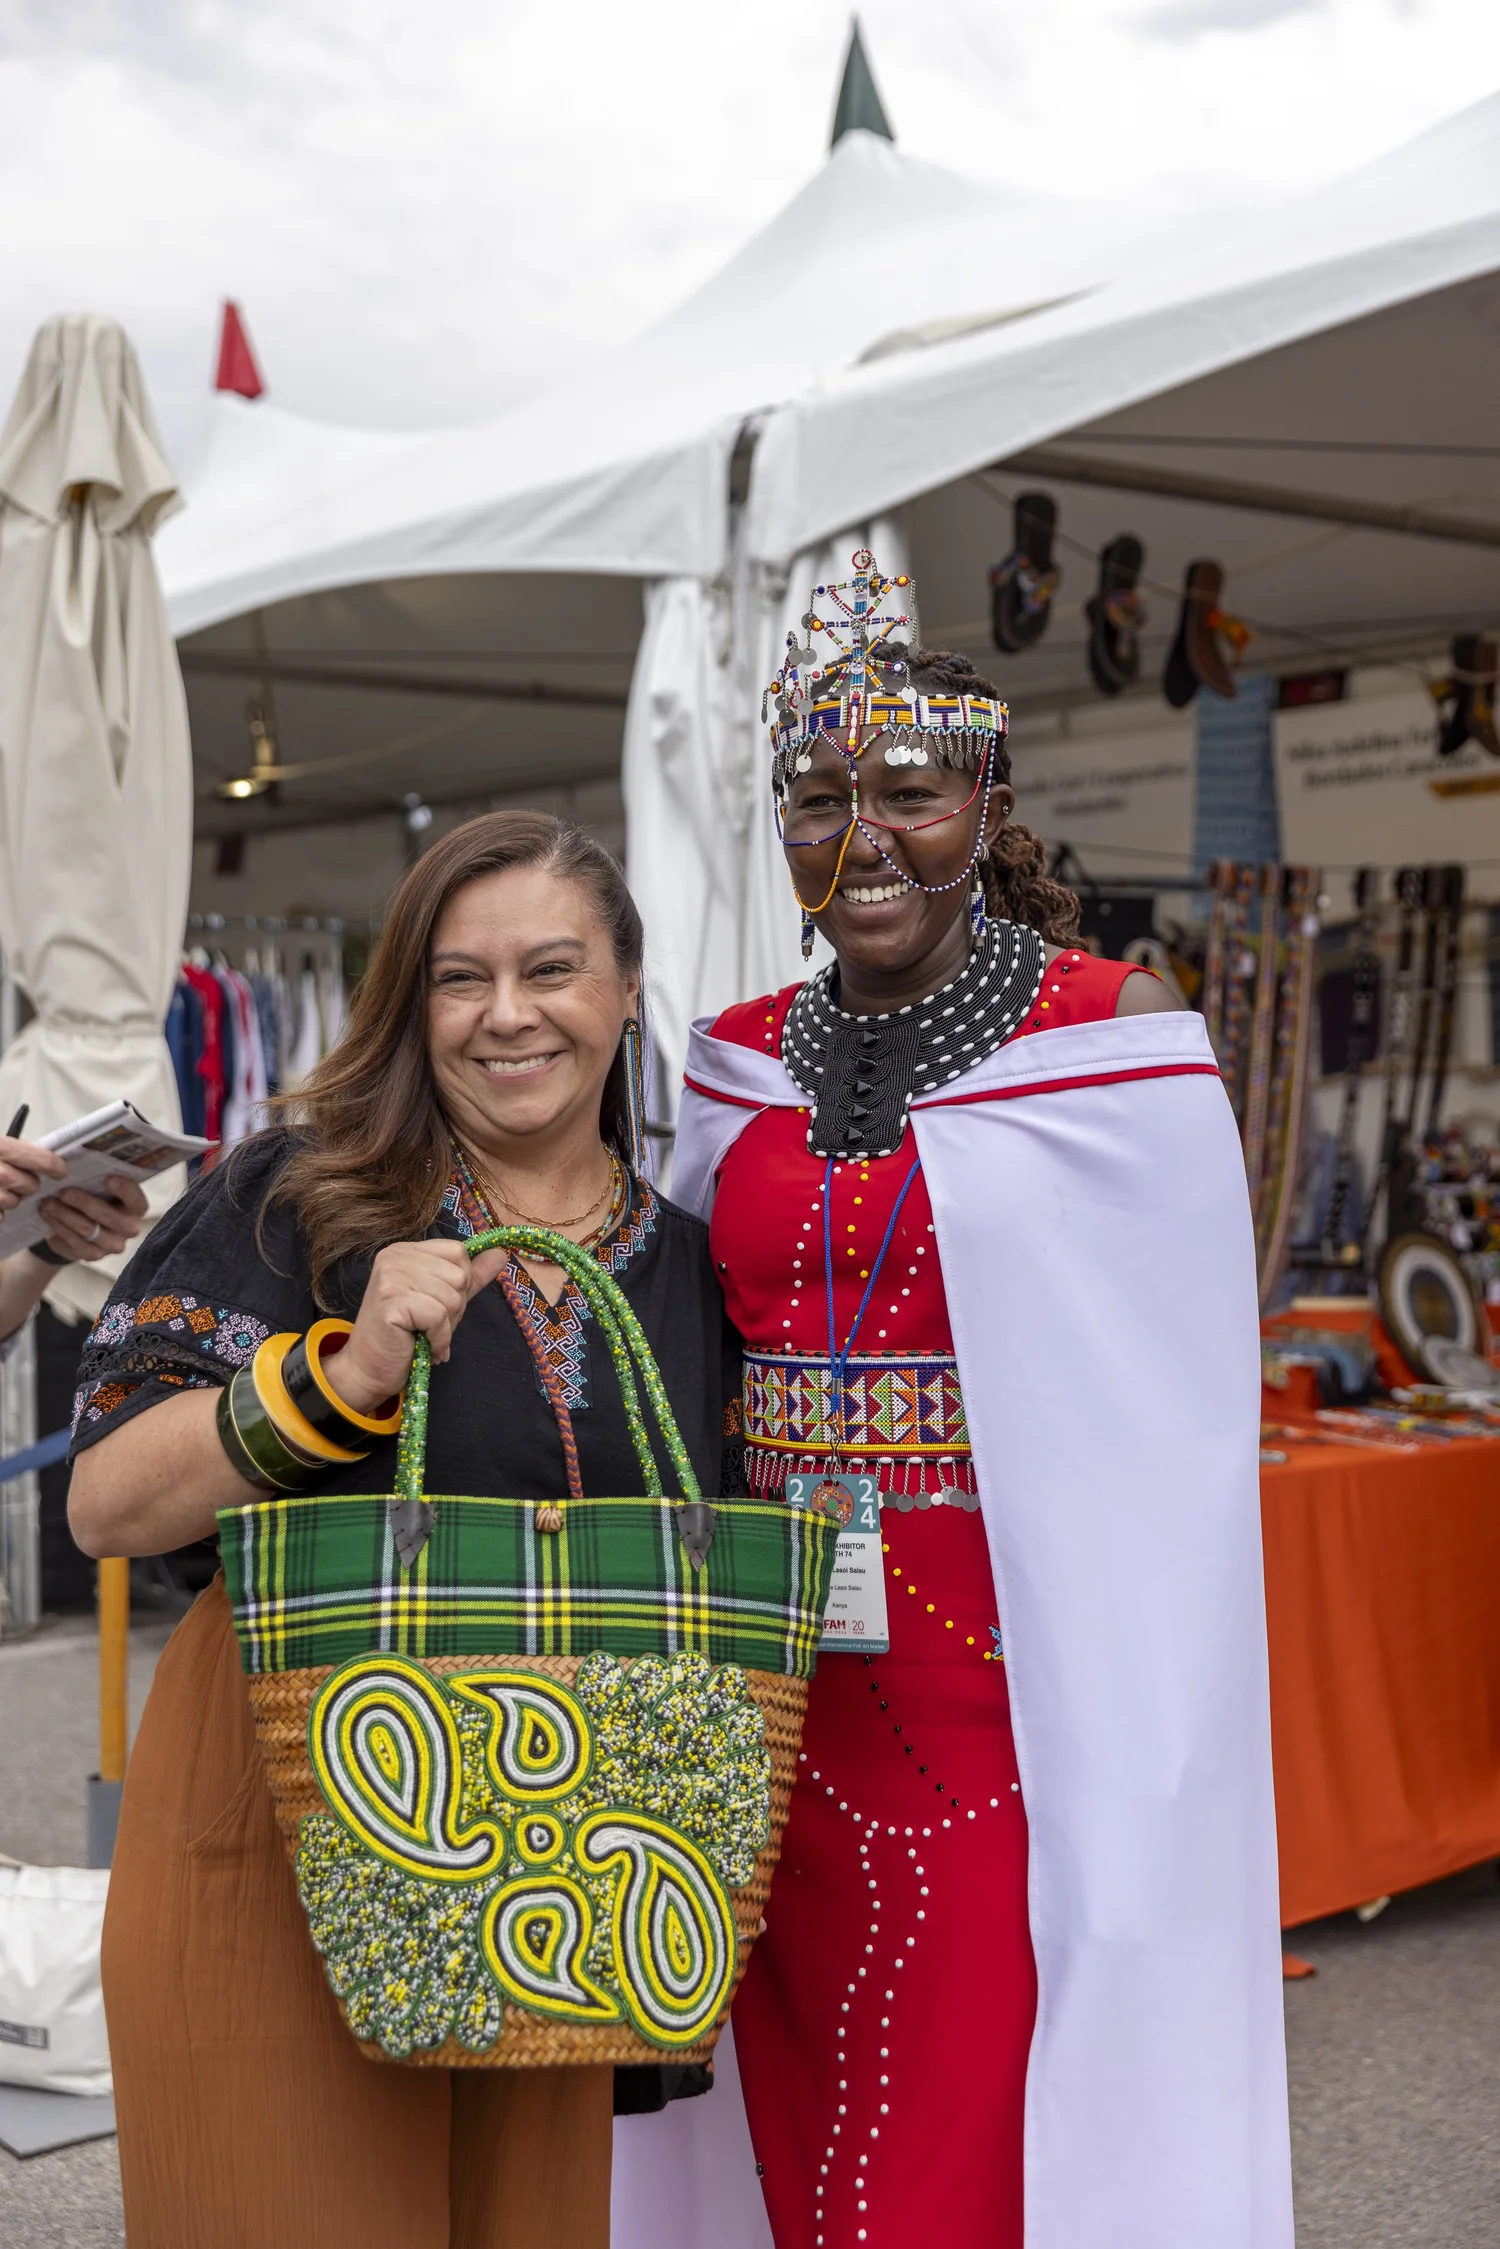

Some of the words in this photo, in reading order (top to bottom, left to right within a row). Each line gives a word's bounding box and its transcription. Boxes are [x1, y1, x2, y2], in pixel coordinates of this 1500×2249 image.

[789, 1478, 804, 1502] 2
[858, 1478, 874, 1503] 2
[860, 1505, 876, 1529] 4
[824, 1620, 846, 1629] FAM
[852, 1620, 865, 1631] 20
